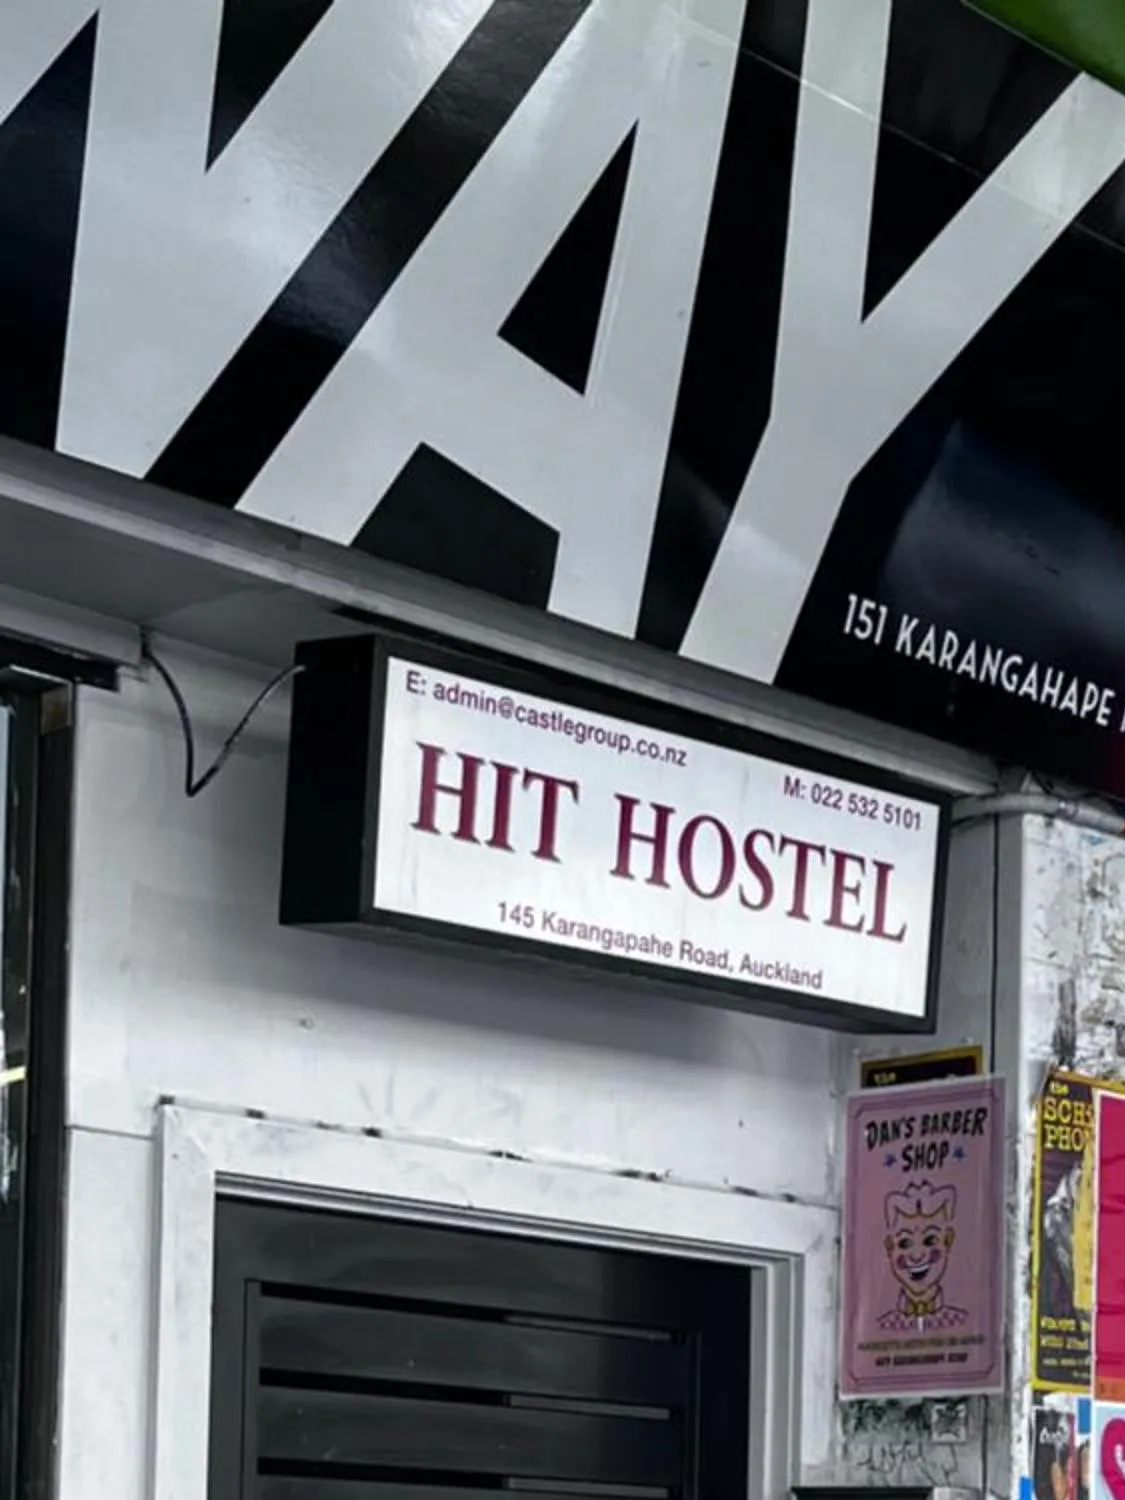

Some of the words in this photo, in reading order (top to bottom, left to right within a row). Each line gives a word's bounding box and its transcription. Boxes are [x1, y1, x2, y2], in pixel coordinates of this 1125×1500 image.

[842, 592, 889, 643] 151
[895, 613, 1116, 730] KARANGAHAPE
[406, 671, 427, 695] E:
[433, 681, 688, 768] admin@castlegroup.co.nz
[411, 742, 579, 864] HIT
[610, 793, 907, 943] HOSTEL
[783, 775, 806, 800] M:
[810, 781, 846, 811] 022
[847, 790, 880, 820] 532
[883, 801, 922, 831] 5101
[497, 902, 536, 929] 145
[541, 910, 674, 960] Karangapahe
[679, 939, 735, 973] Road,
[739, 953, 823, 989] Auckland
[866, 1116, 916, 1151] DAN'S
[921, 1106, 988, 1137] BARBER
[902, 1140, 950, 1173] SHOP
